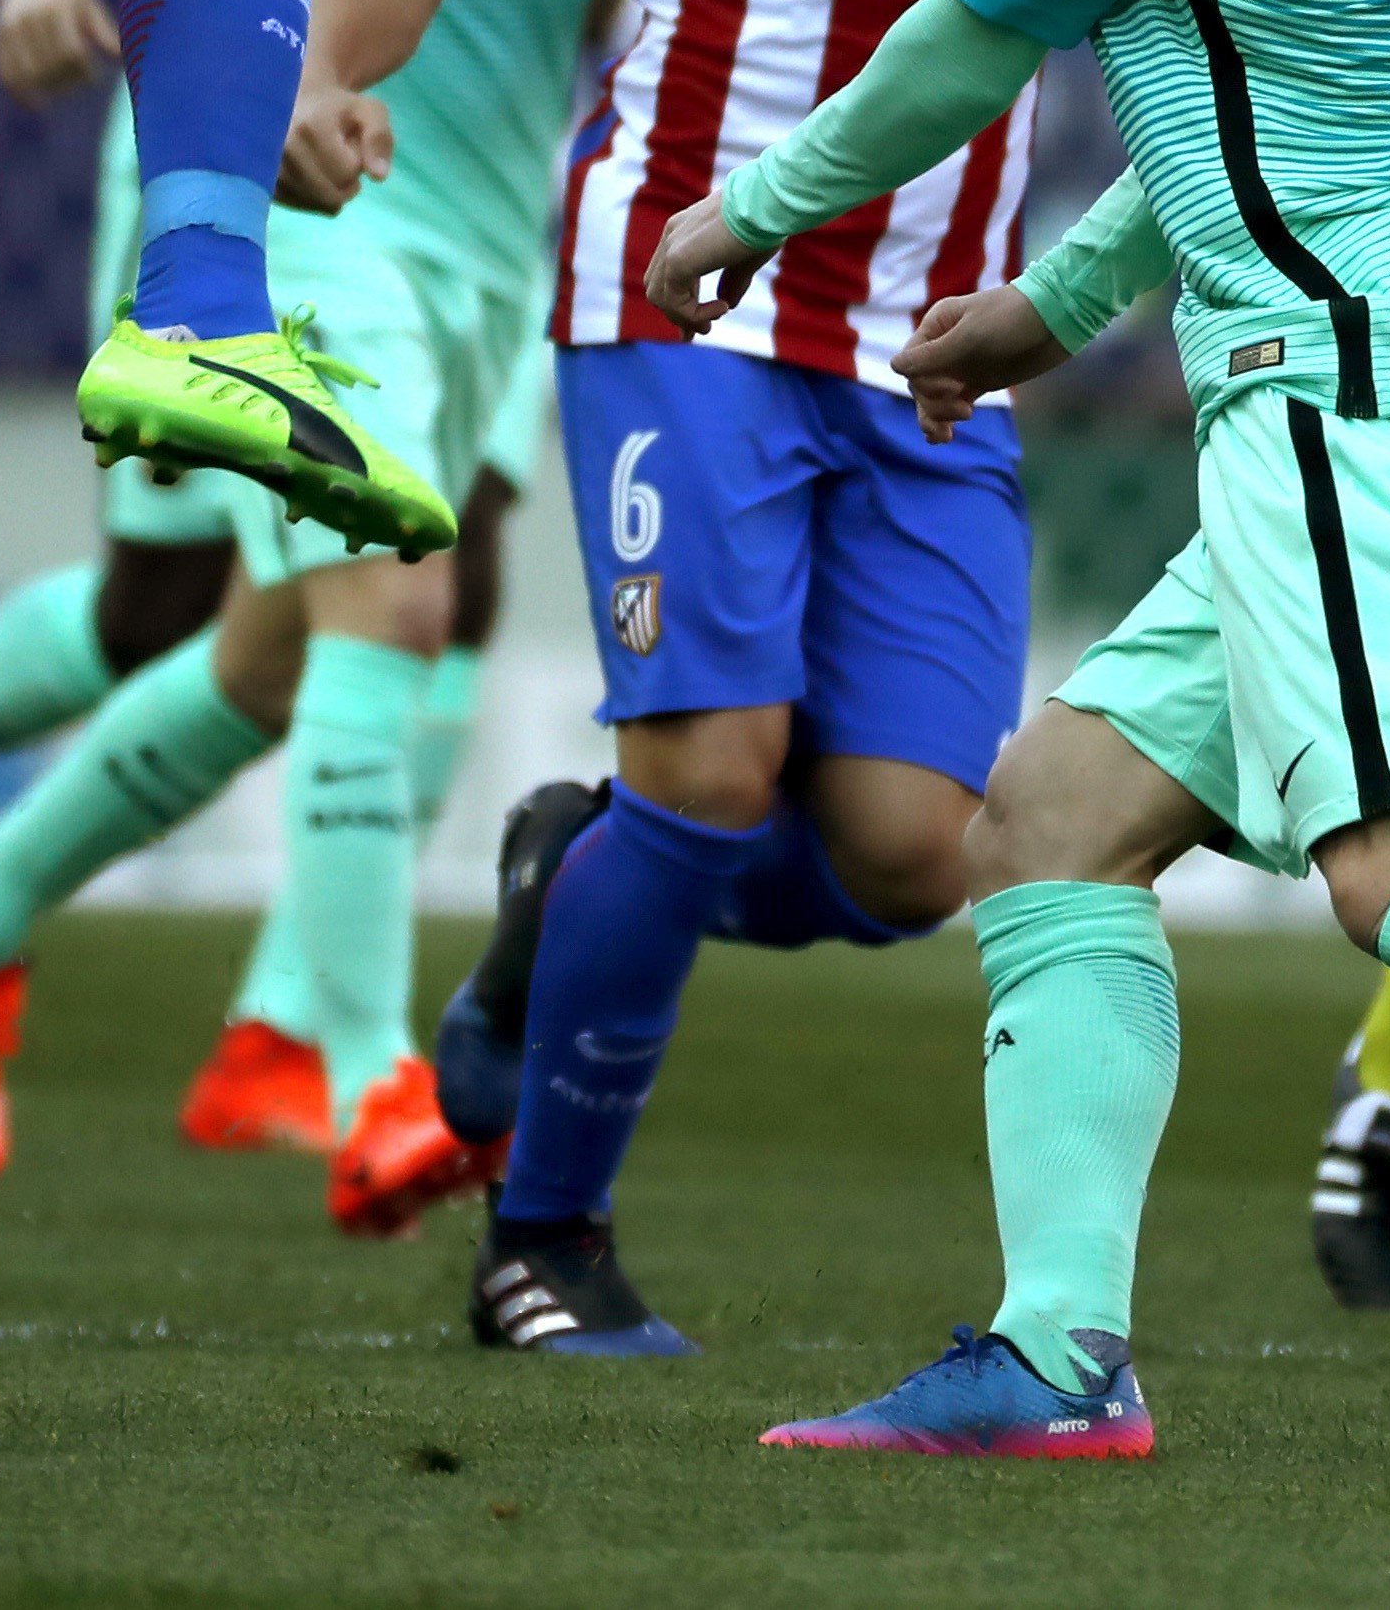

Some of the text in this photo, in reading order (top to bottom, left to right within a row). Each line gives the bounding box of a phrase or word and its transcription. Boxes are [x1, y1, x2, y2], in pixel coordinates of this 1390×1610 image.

[611, 429, 663, 563] 6
[1105, 1401, 1124, 1419] 10
[1047, 1419, 1090, 1435] ANTO
